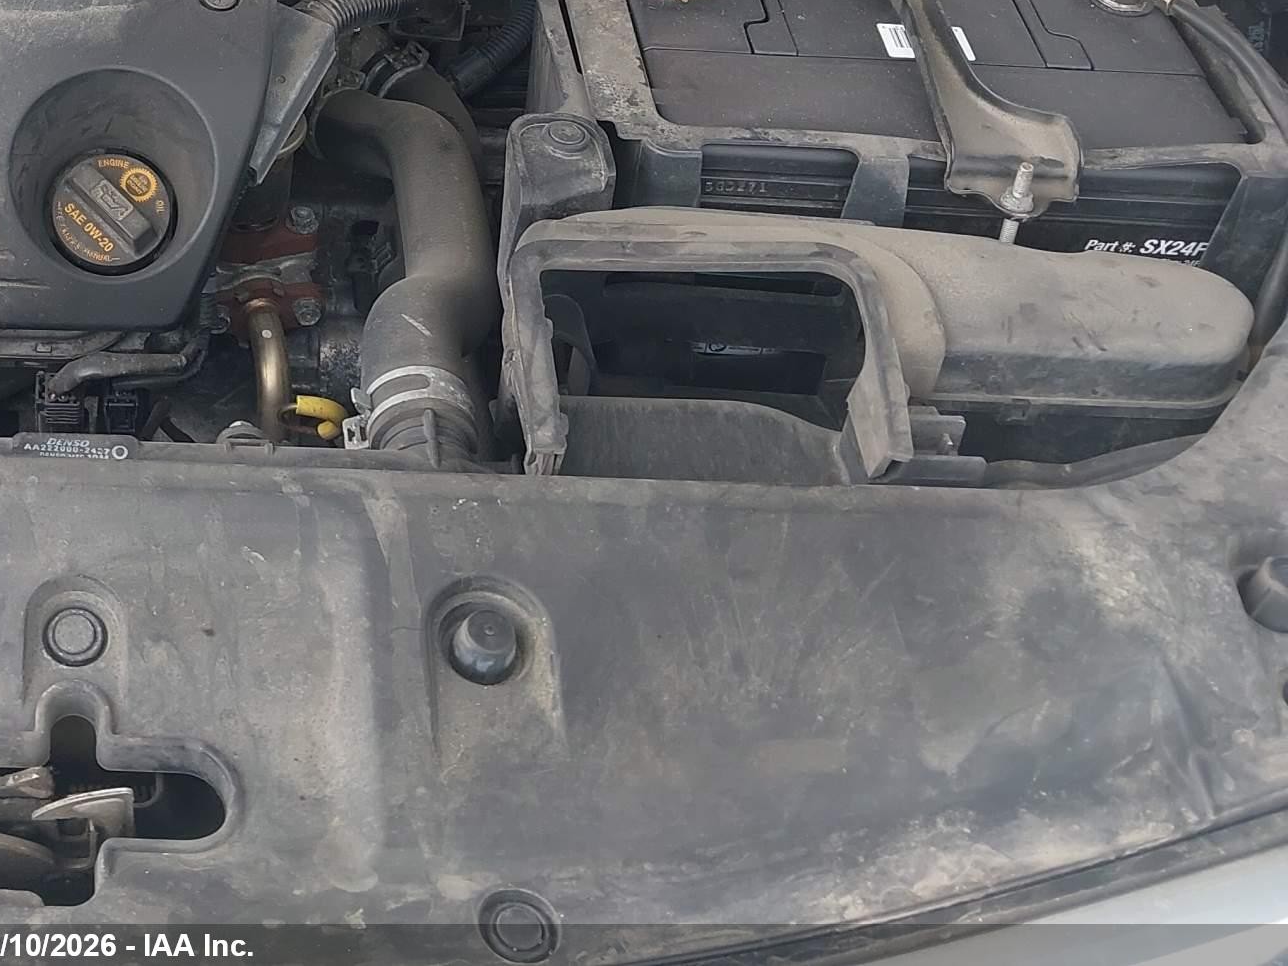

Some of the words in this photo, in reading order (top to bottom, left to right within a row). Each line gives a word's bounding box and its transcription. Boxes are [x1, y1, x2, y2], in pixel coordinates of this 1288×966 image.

[97, 158, 130, 169] ENGINE
[155, 200, 166, 213] OIL
[64, 203, 87, 226] SAE
[84, 222, 115, 253] 0W-20
[1085, 239, 1121, 252] Part
[1140, 239, 1209, 256] SX24F
[47, 438, 90, 447] DENSO
